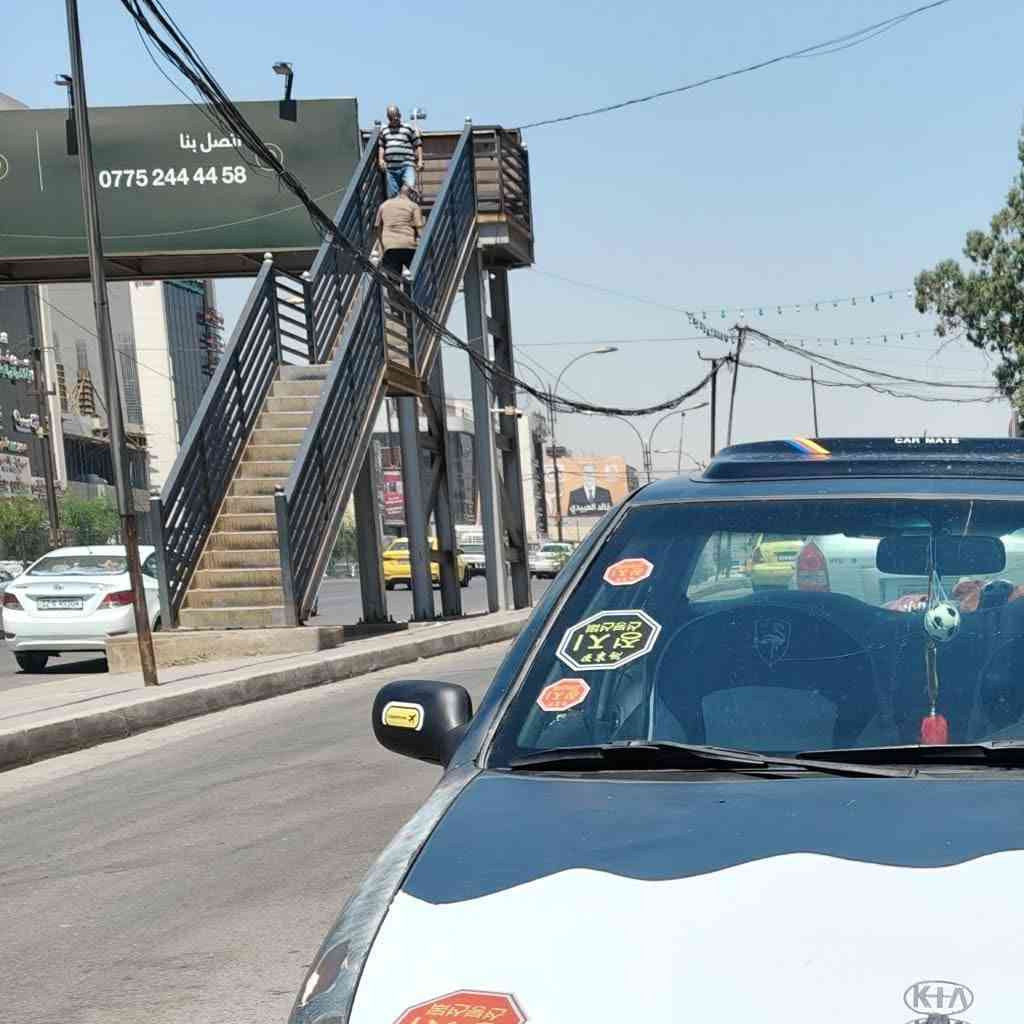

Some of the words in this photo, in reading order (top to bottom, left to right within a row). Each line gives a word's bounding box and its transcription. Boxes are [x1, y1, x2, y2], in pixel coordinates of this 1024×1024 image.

[179, 132, 197, 153] بنا
[98, 168, 149, 188] 0775
[151, 168, 189, 187] 244
[193, 166, 218, 185] 44
[221, 165, 247, 184] 58
[913, 985, 969, 1009] KIA
